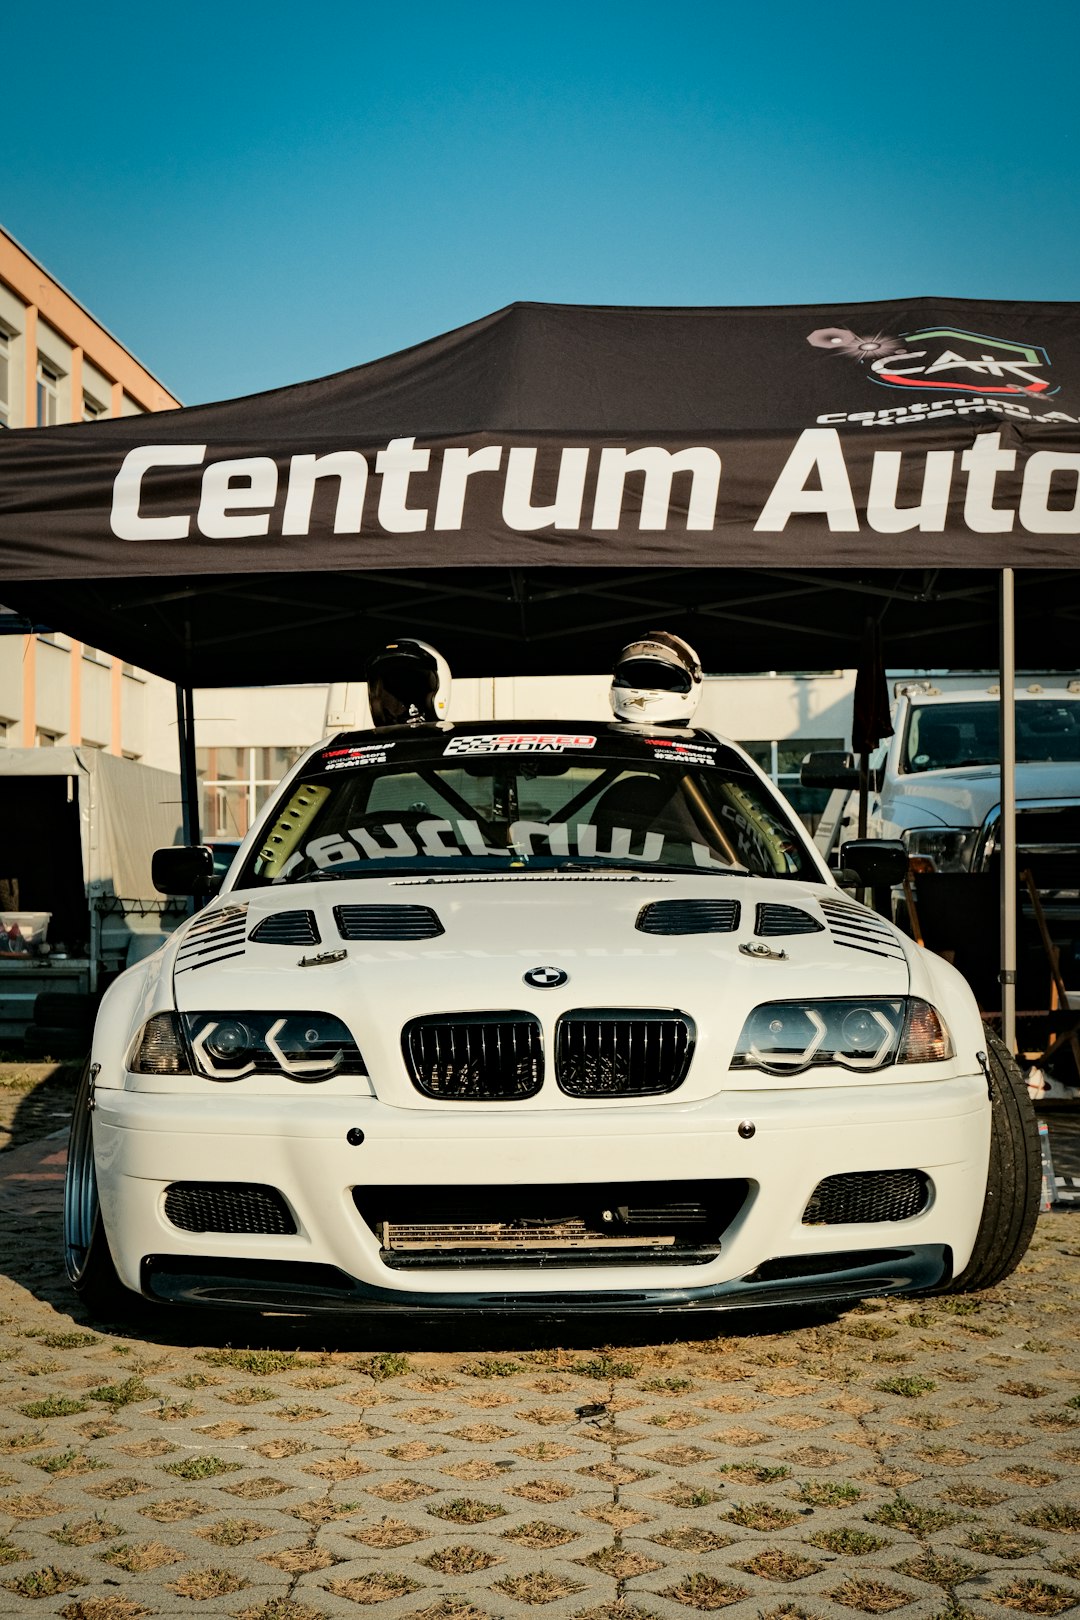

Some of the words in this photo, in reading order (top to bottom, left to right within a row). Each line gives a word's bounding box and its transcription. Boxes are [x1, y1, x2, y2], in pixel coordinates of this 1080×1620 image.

[110, 436, 721, 541] Centrum
[753, 428, 1080, 535] Auto
[491, 735, 596, 744] SPEED
